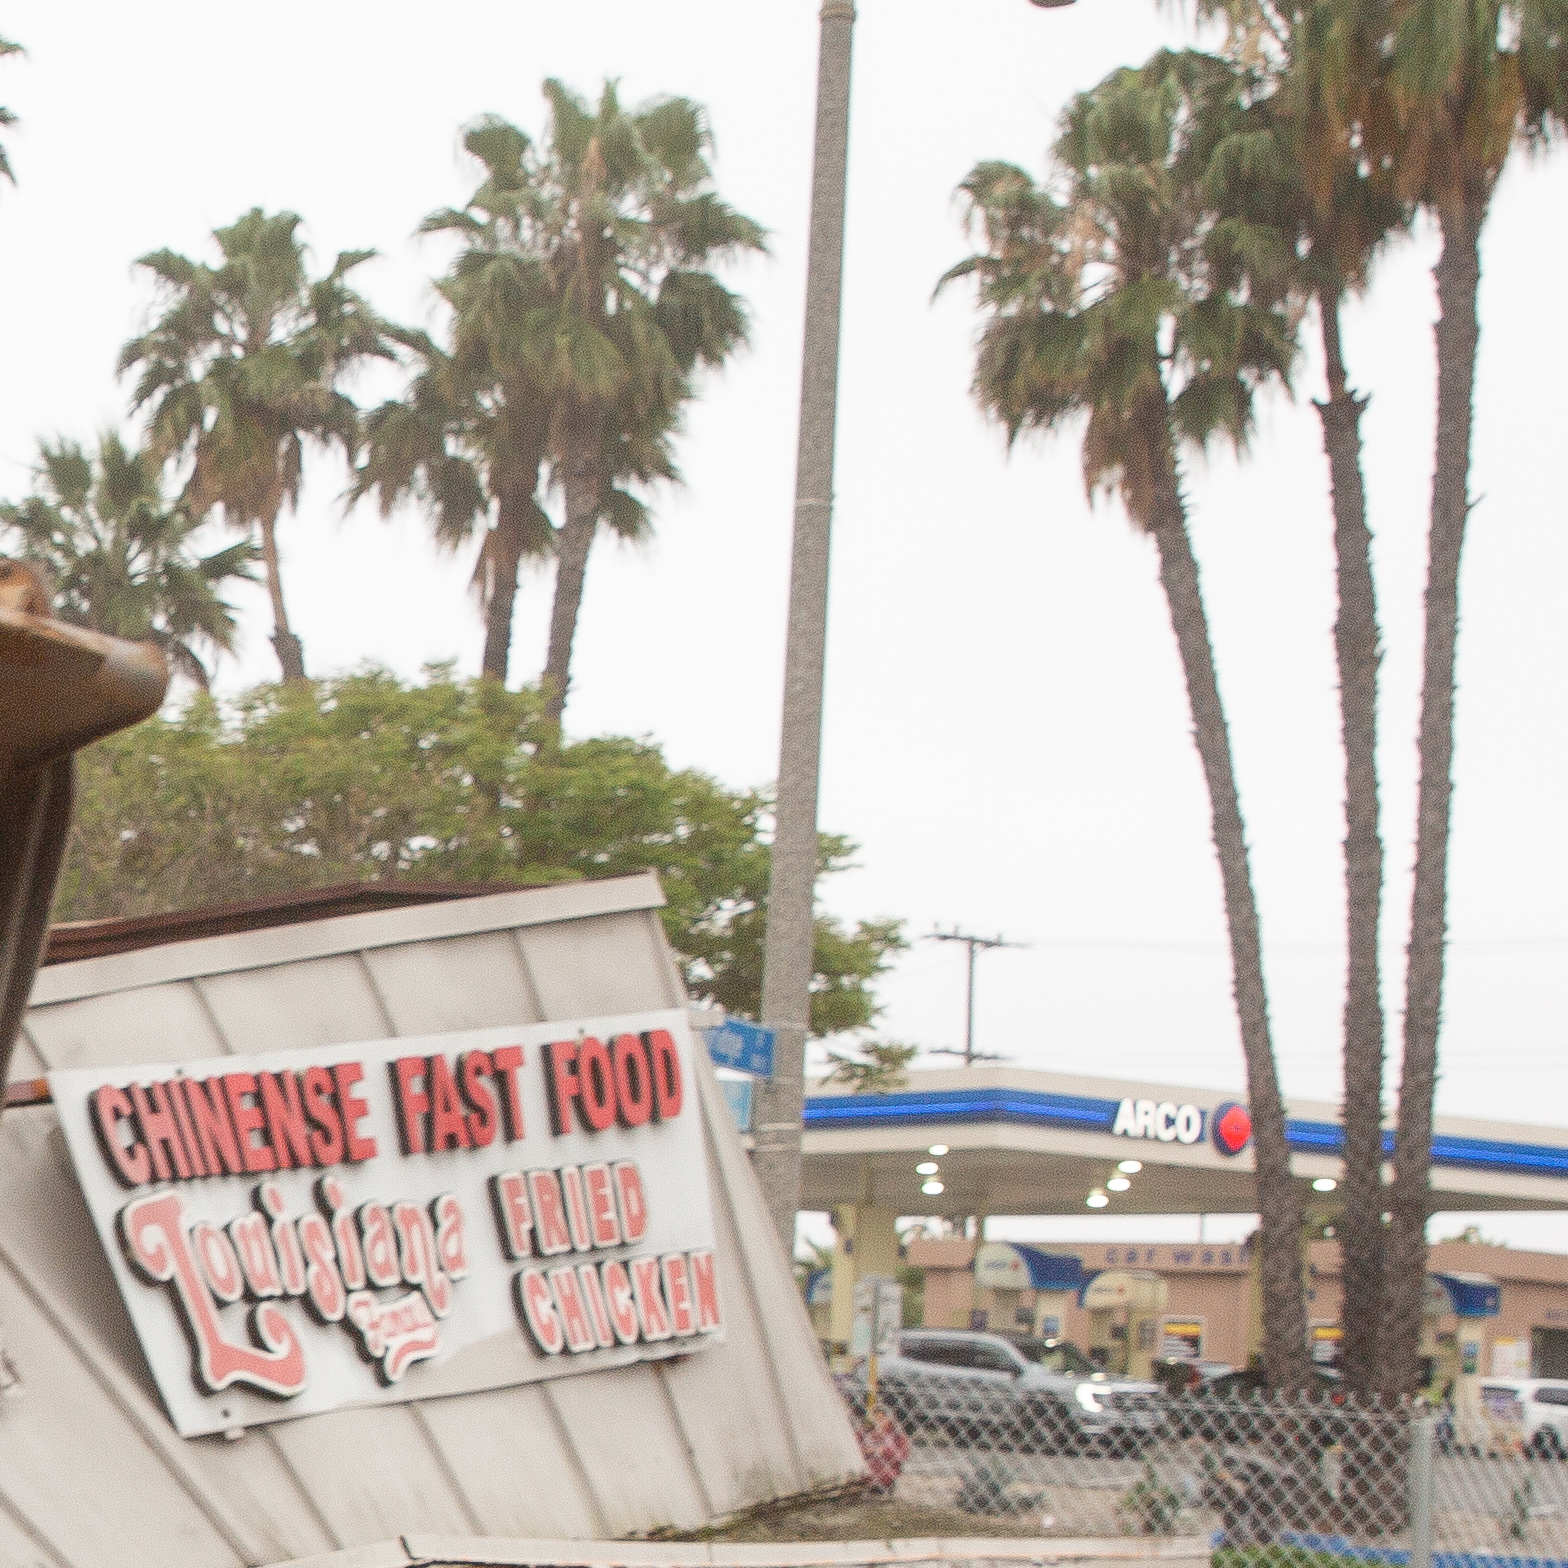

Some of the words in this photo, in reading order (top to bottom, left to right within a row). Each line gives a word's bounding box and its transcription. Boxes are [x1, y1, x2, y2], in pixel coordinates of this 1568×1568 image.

[92, 1062, 377, 1188] CHINENSE
[392, 1045, 525, 1155] FAST
[545, 1028, 684, 1137] FOOD
[1114, 1098, 1202, 1145] ARCO
[494, 1161, 648, 1260] FRIED
[119, 1175, 468, 1396] Louisiana
[516, 1250, 721, 1354] CHICKEN
